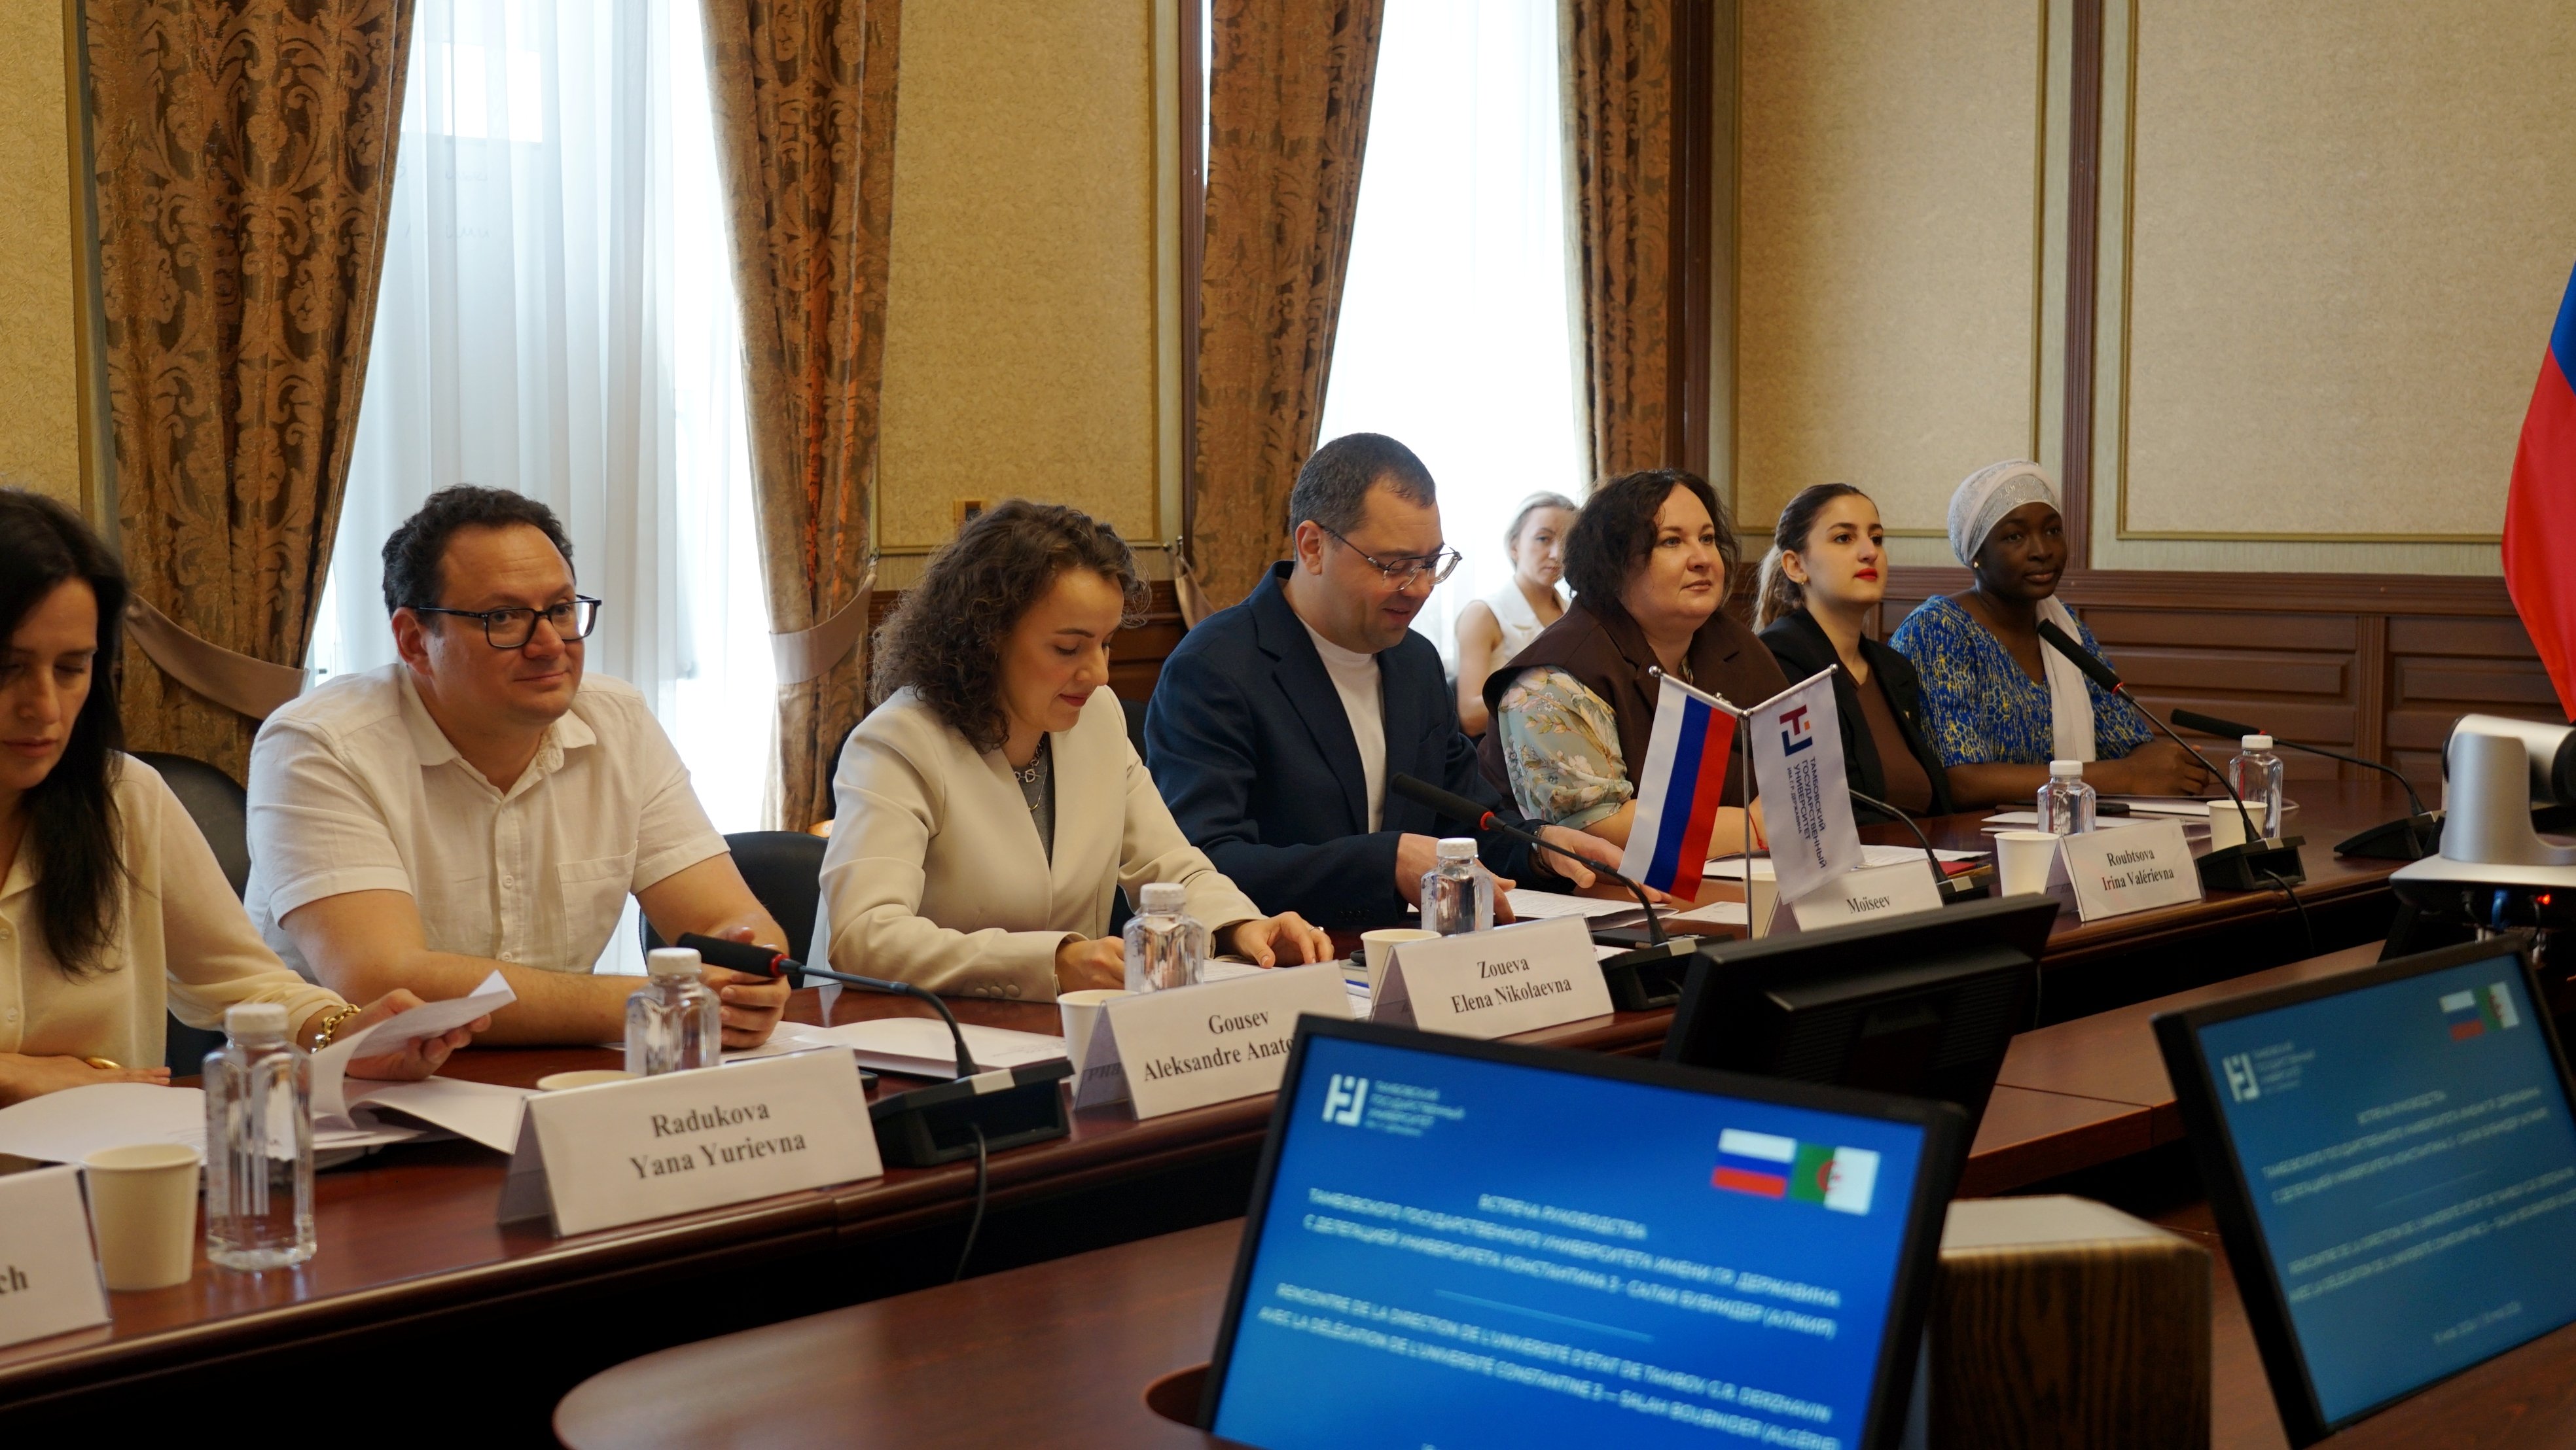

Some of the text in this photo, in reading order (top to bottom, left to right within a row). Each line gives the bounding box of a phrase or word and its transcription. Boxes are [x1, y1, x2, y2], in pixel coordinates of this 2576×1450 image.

[1794, 763, 1811, 840] УНИВЕРСИТЕТ
[1810, 756, 1825, 832] ТАМБОВСКИЙ
[1791, 792, 1802, 834] ДЕРЖАВИНА
[1802, 760, 1827, 869] ГОСУДАРСТВЕННЫЙ
[2106, 849, 2155, 867] Roubtsova
[2102, 868, 2175, 891] Irina Valérievna
[1846, 896, 1890, 914] Moïseev
[1476, 958, 1530, 979] Zoueva
[1450, 978, 1572, 1014] Elena Nikolaevna
[1208, 1012, 1268, 1034] Gousev
[1144, 1048, 1242, 1082] Aleksandre
[651, 1103, 770, 1138] Radukova
[630, 1134, 807, 1179] Yana Yurievna
